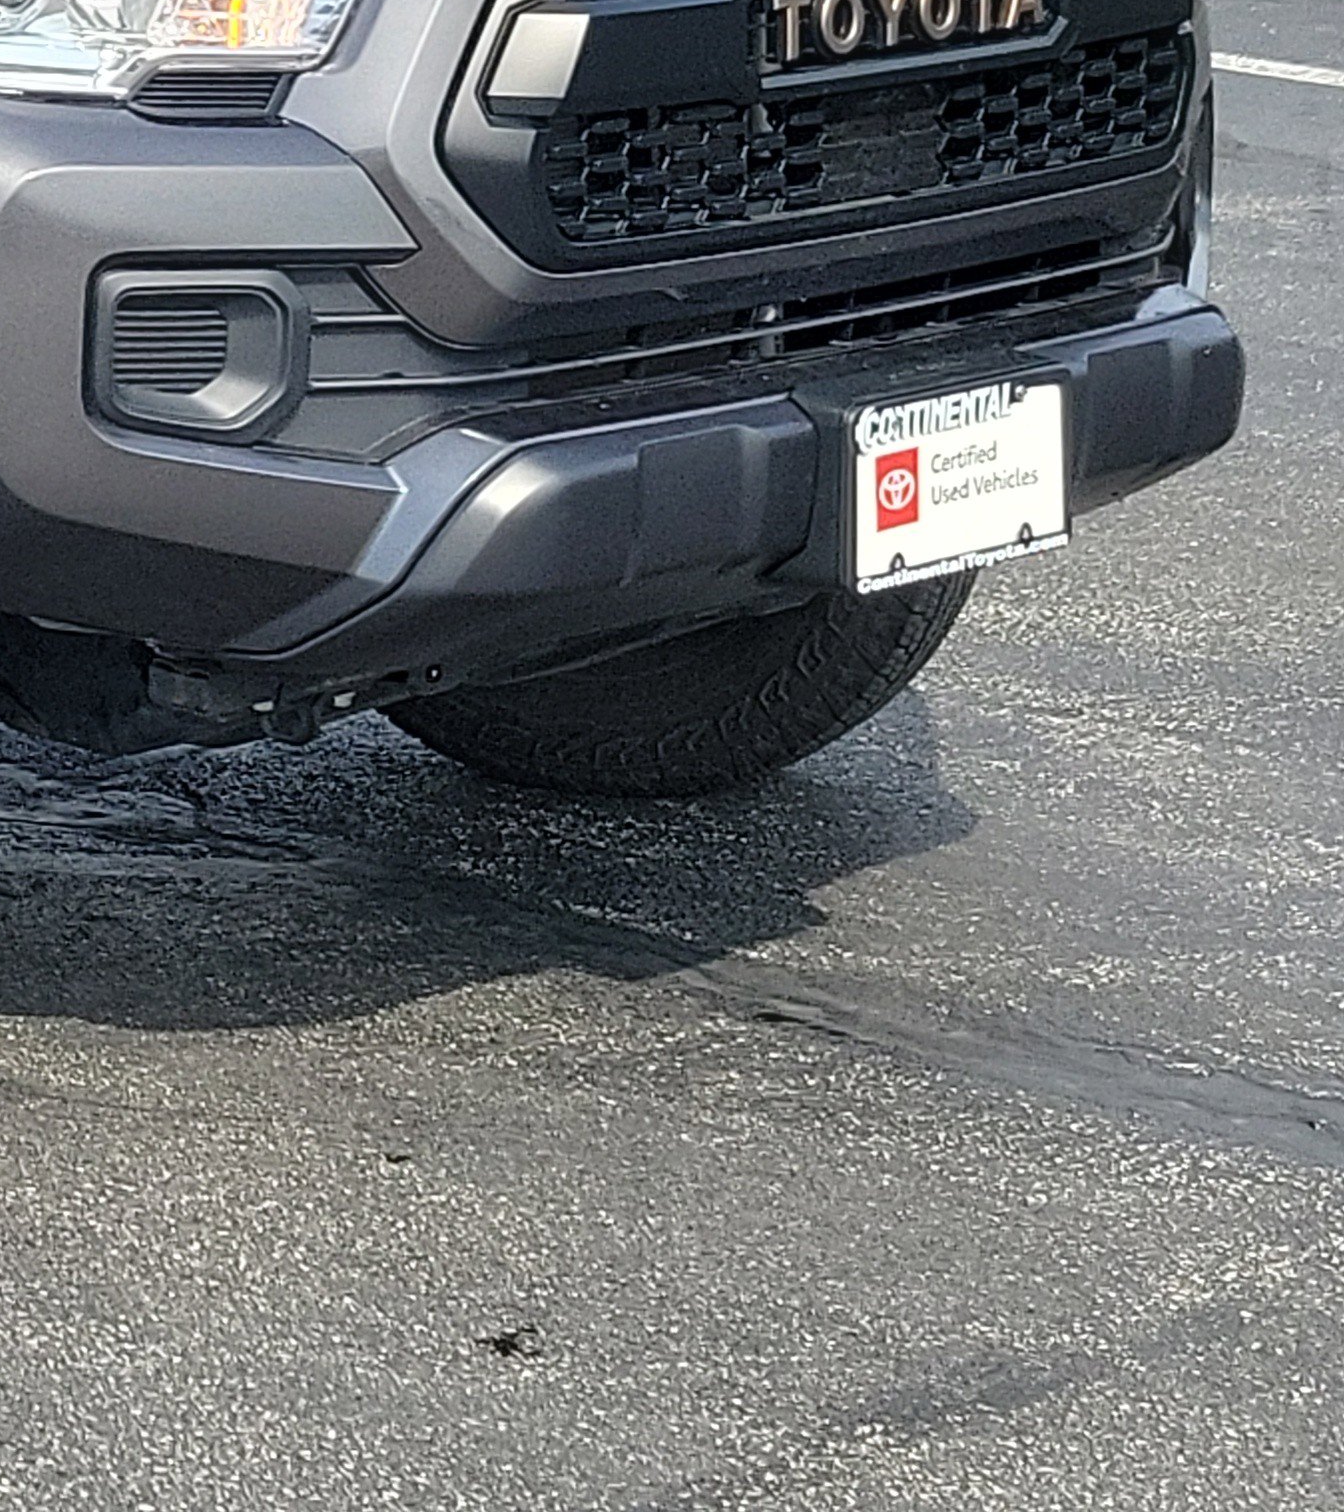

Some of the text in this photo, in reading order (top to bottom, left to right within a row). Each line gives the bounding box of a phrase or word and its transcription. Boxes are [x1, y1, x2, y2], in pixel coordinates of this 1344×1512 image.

[856, 381, 1013, 455] CONTINENTAL
[930, 440, 998, 474] Certified
[930, 467, 1039, 506] Used Vehicles
